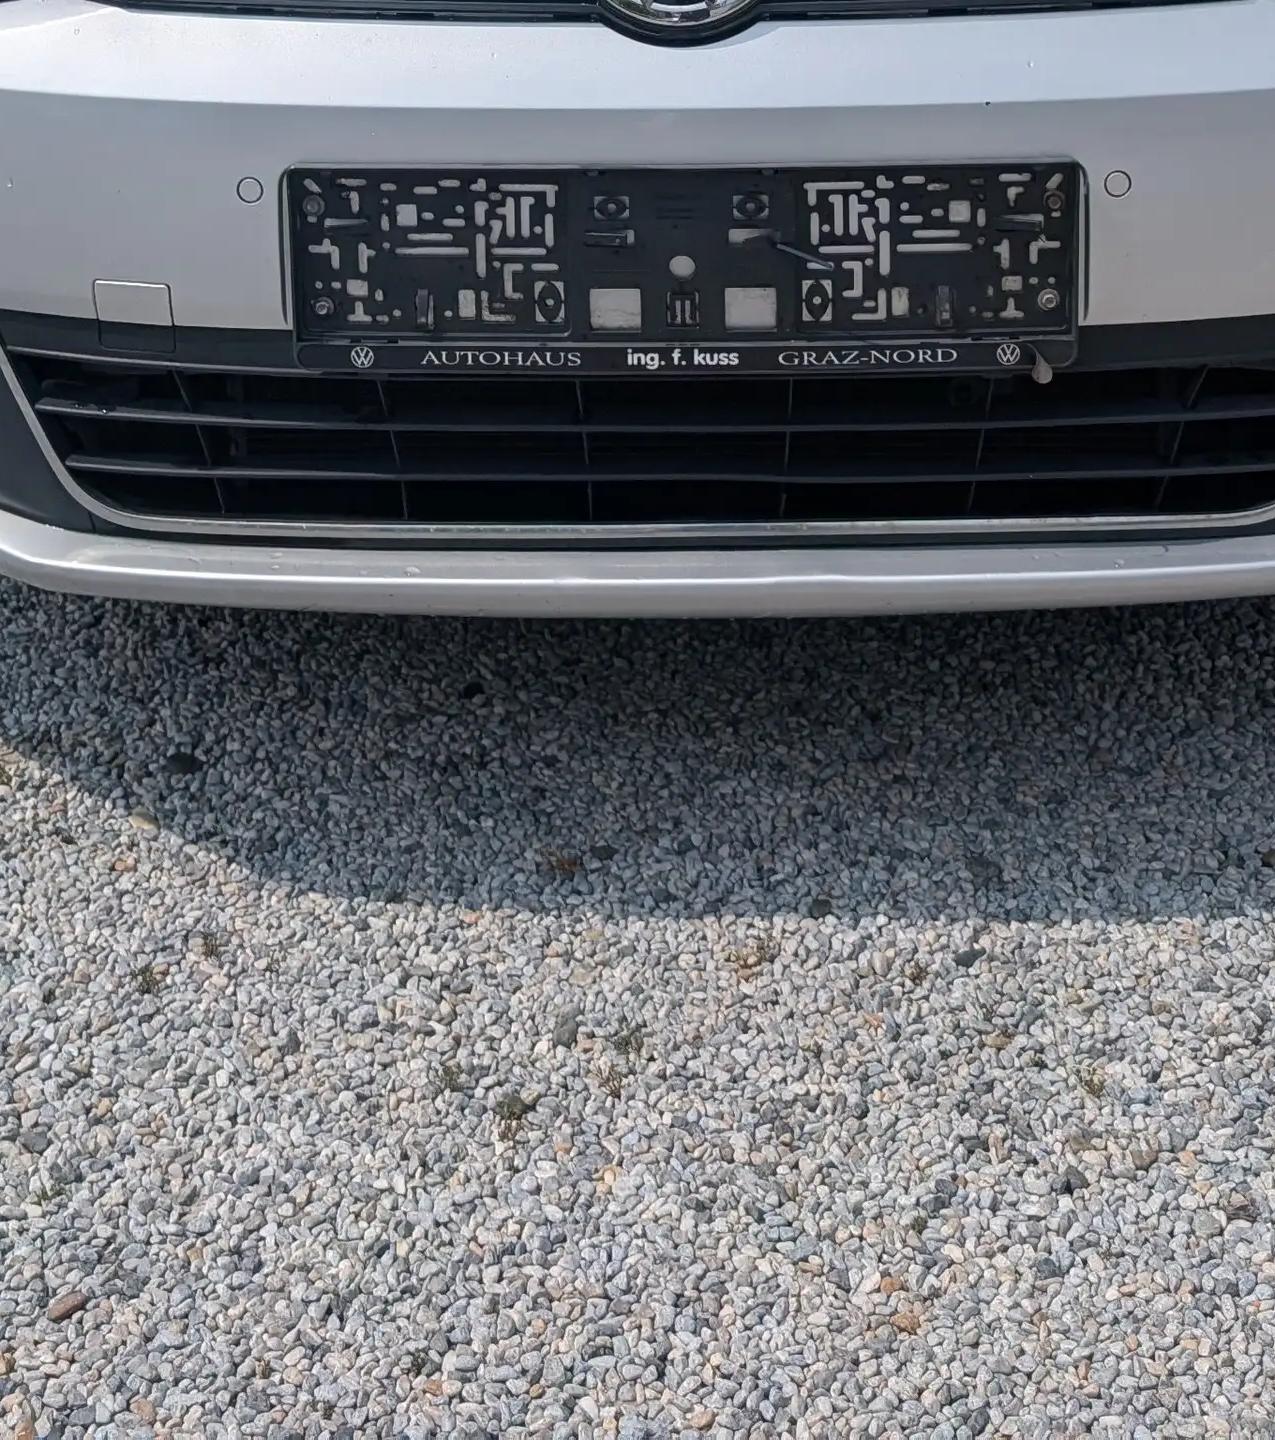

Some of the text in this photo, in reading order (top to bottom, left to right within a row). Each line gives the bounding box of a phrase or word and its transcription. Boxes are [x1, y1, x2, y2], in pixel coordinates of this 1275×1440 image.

[420, 350, 582, 367] AUTOHAUS
[626, 348, 740, 370] ing. f. kuss
[777, 347, 959, 366] GRAZ-NORD
